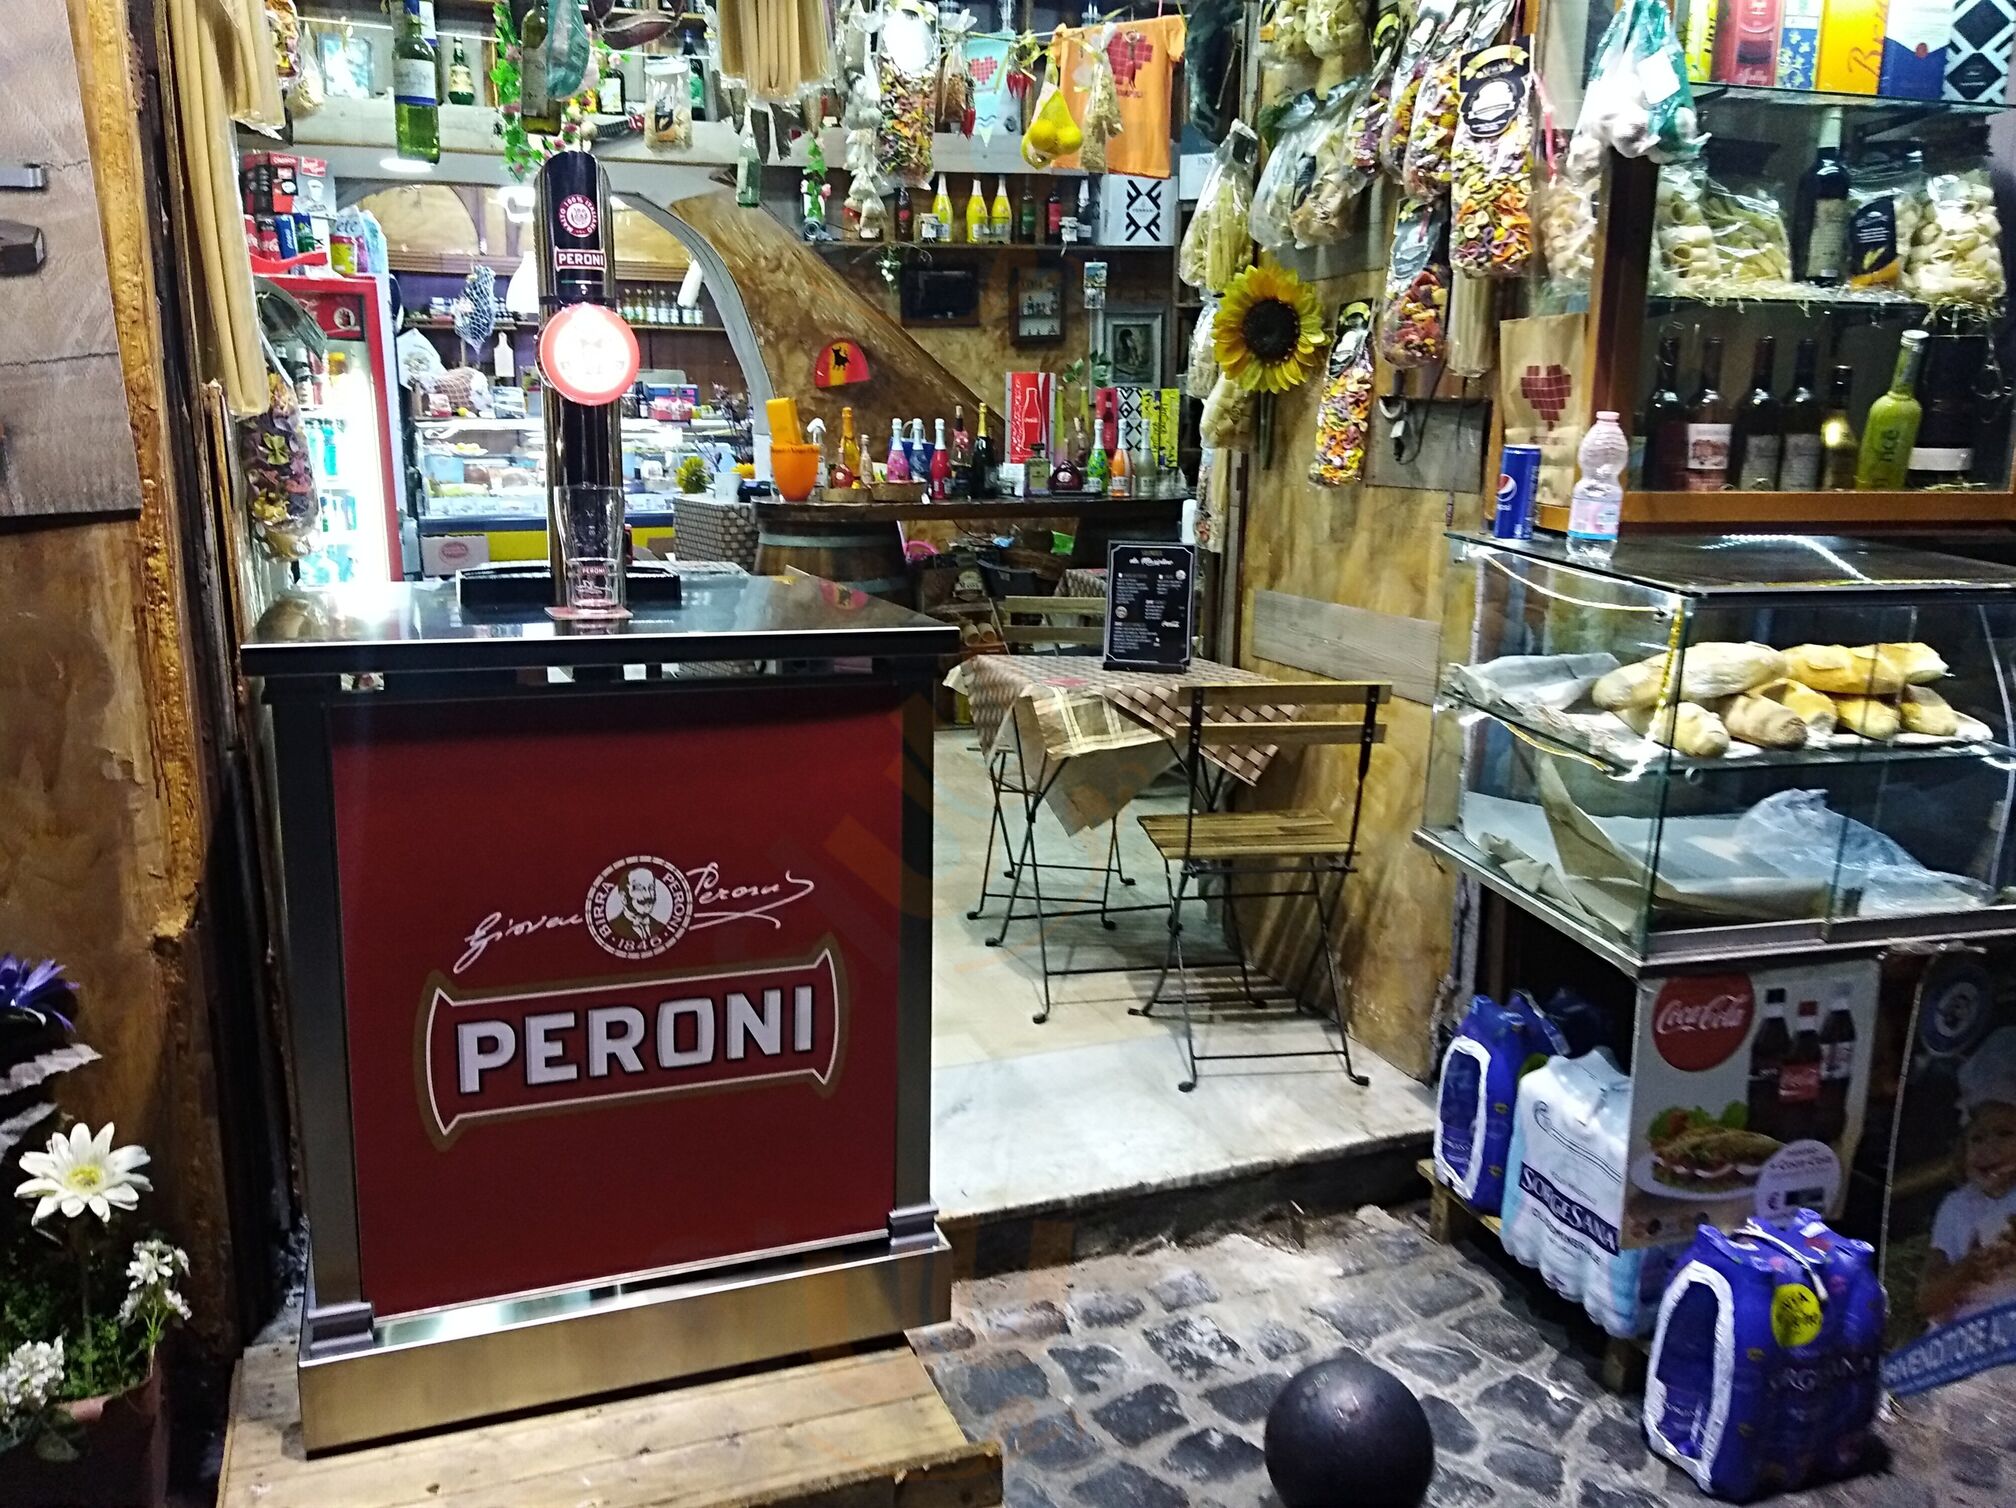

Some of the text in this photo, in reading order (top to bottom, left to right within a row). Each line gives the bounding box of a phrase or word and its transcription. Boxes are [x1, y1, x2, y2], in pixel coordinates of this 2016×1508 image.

[564, 196, 583, 207] 100%
[558, 253, 604, 265] PERONI
[593, 872, 685, 939] BIRRA PERONI
[617, 935, 662, 951] 1846
[1656, 995, 1747, 1034] Coca-Cola
[457, 985, 813, 1094] PERONI
[1521, 1166, 1617, 1252] SORGESANA
